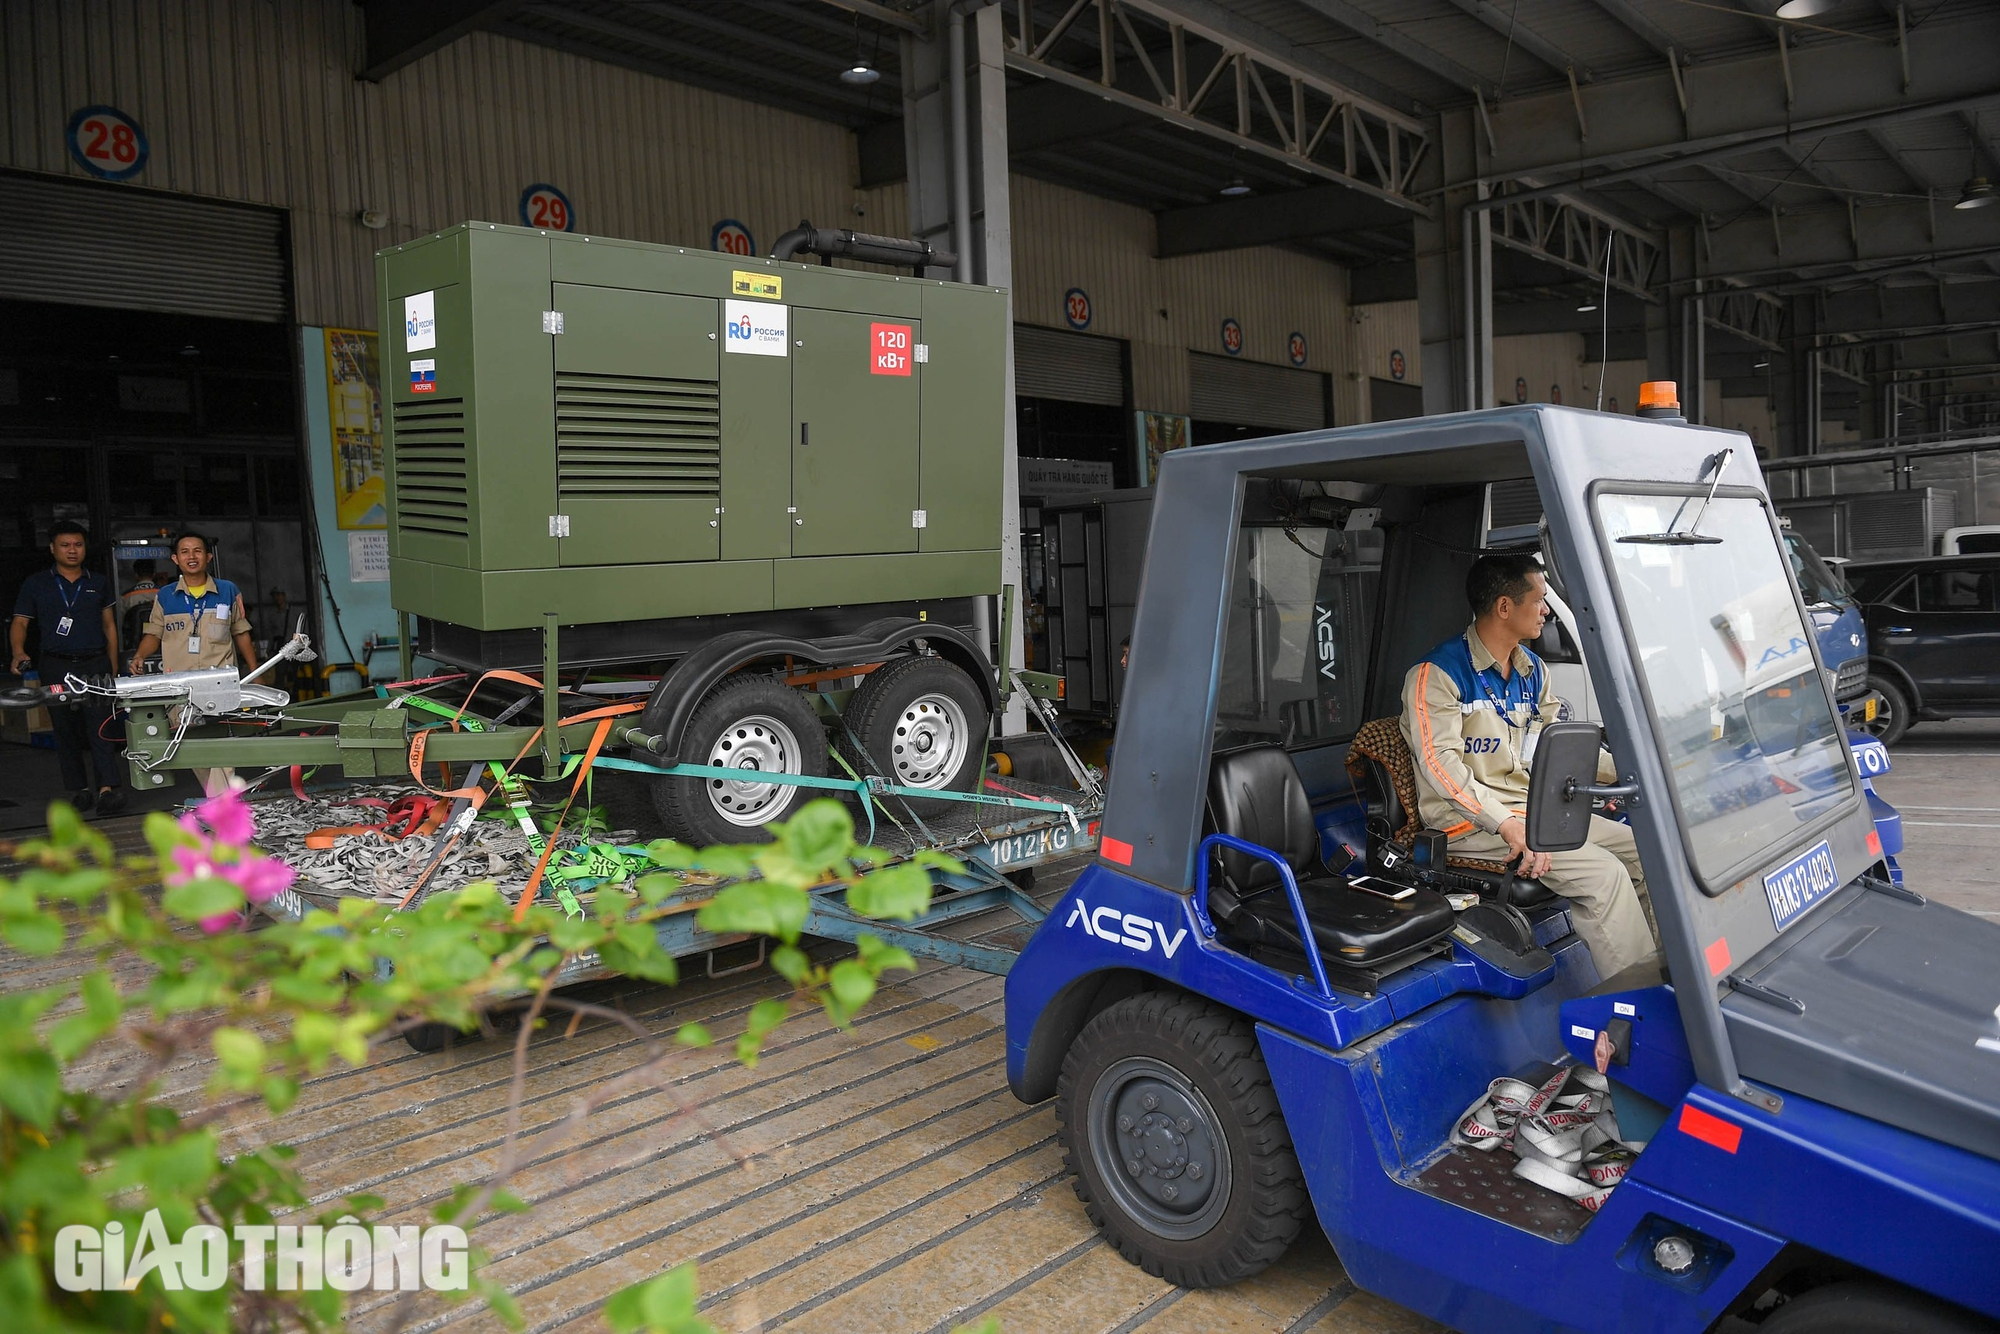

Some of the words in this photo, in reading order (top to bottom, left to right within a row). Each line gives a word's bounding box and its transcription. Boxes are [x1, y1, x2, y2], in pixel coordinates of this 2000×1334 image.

[83, 119, 136, 164] 28
[531, 195, 566, 230] 29
[720, 231, 749, 256] 30
[1069, 297, 1087, 320] 32
[754, 327, 785, 337] РОССИЯ
[878, 331, 905, 349] 120
[1225, 327, 1240, 348] 33
[1291, 340, 1304, 358] 34
[878, 352, 905, 369] кВт
[166, 621, 185, 632] 6179
[1315, 605, 1336, 680] ACSV
[411, 736, 426, 768] Cargo
[1464, 736, 1501, 754] 5037
[588, 865, 617, 877] AIR
[1065, 897, 1187, 960] ACSV
[1576, 1029, 1590, 1037] OFF
